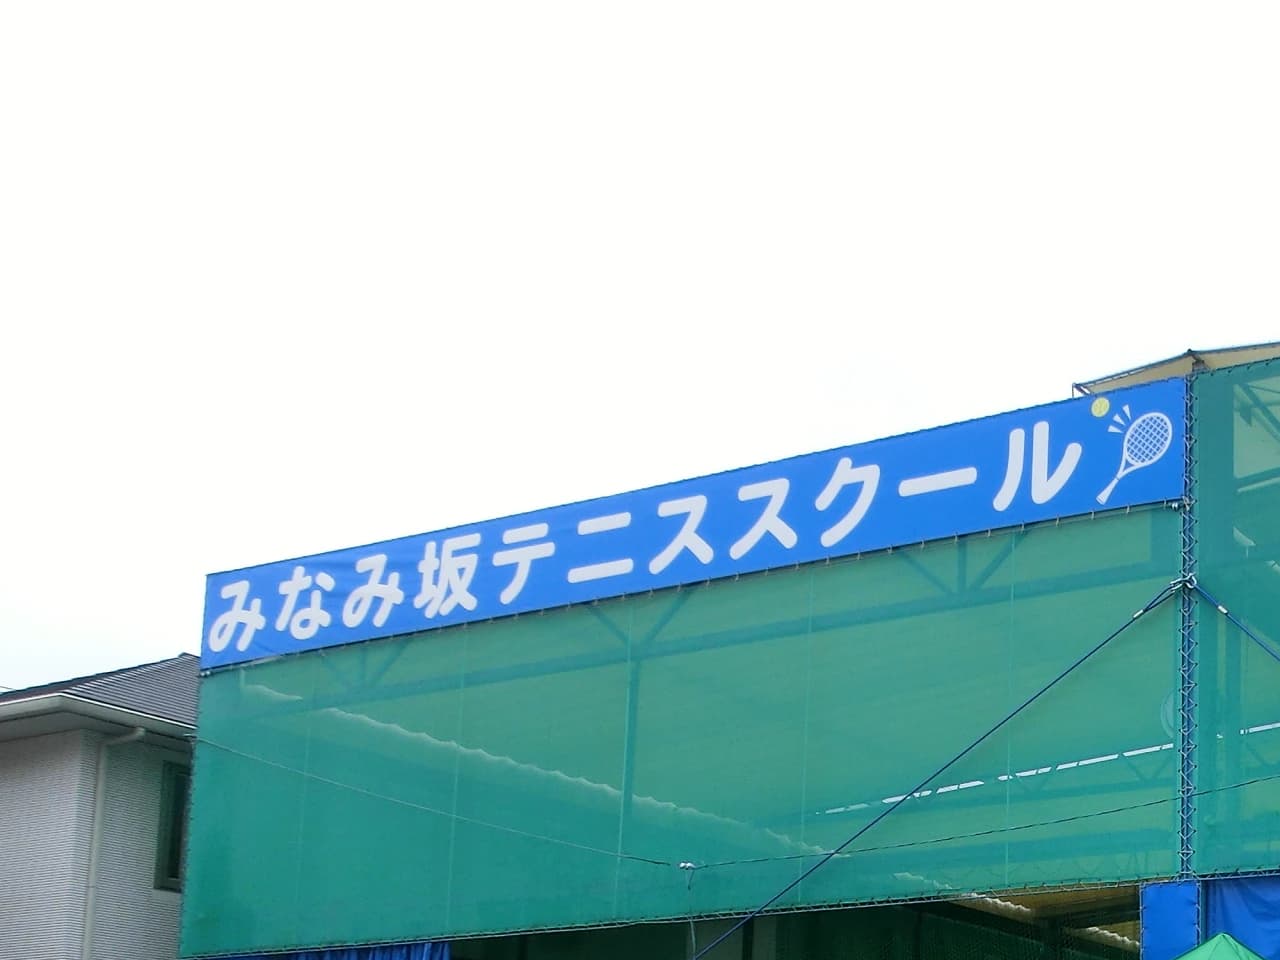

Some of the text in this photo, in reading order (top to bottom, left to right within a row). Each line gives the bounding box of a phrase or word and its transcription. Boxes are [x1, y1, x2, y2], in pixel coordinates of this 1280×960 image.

[208, 421, 1081, 651] みなみ坂テニススクール
